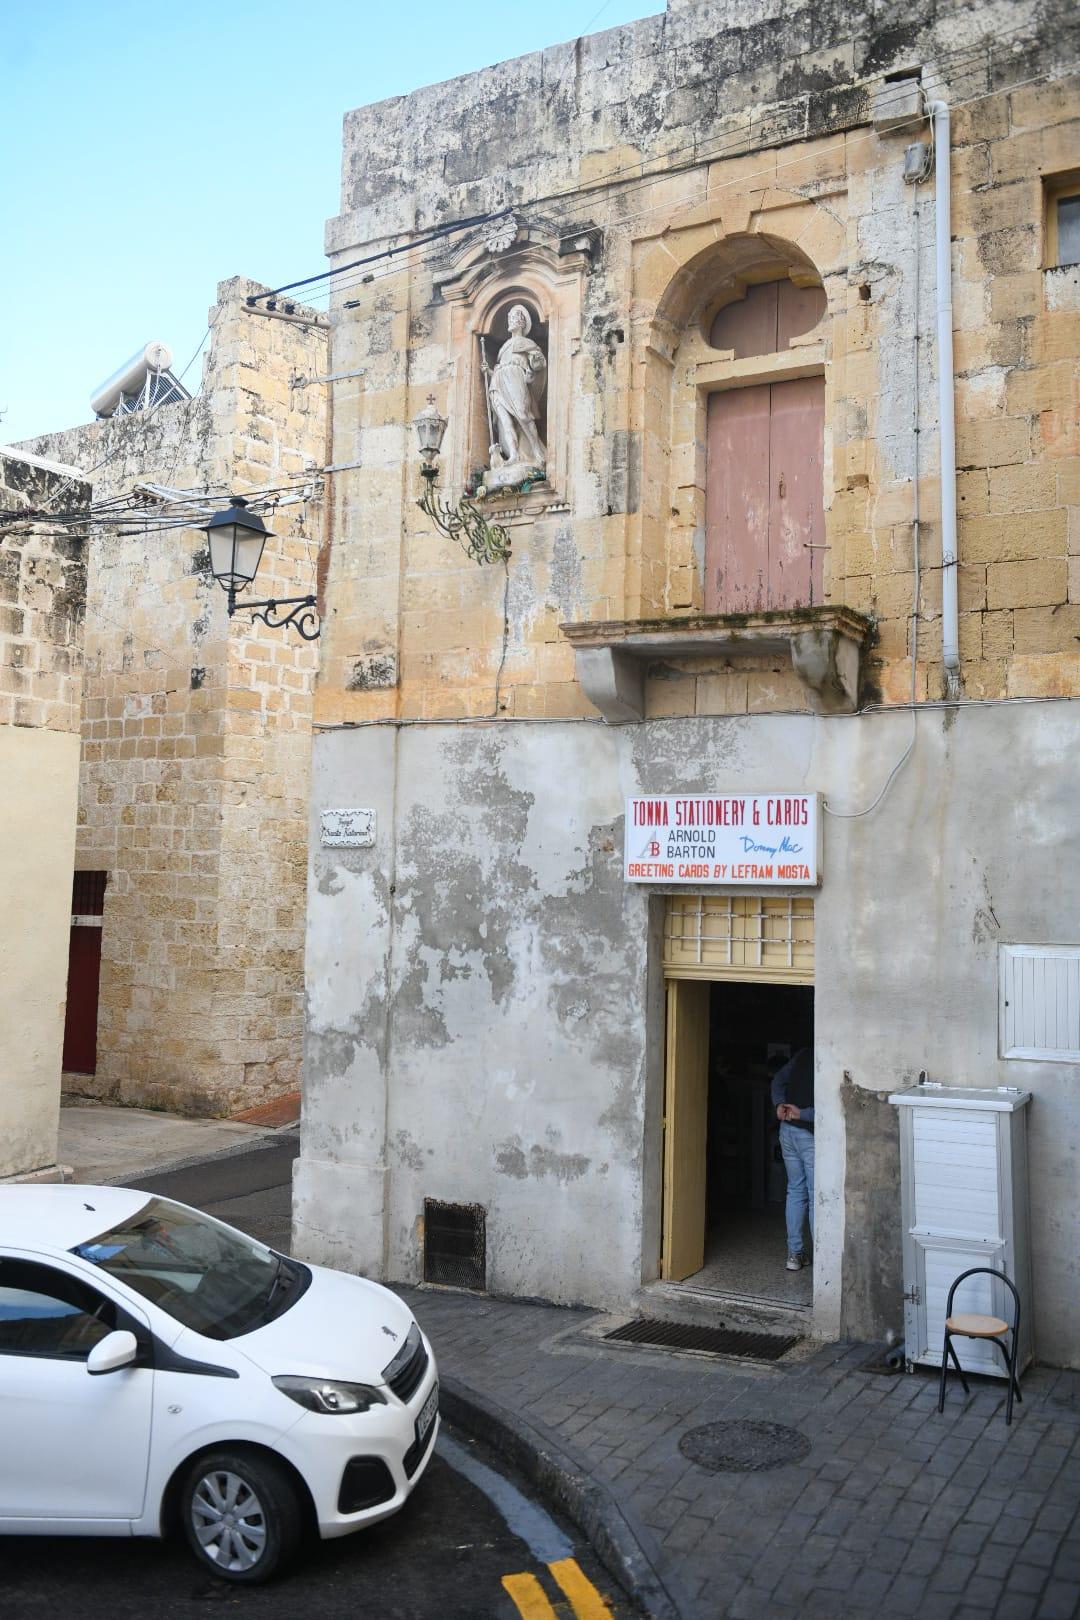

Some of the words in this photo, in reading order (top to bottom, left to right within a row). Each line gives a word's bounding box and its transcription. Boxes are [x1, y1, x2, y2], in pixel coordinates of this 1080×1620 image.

[633, 800, 669, 826] TONNA
[675, 799, 746, 826] STATIONERY
[752, 799, 760, 826] &
[767, 799, 808, 826] CARDS
[668, 829, 716, 843] ARNOLD
[667, 846, 716, 859] BARTON
[628, 863, 674, 878] GREETING
[678, 864, 709, 878] CARDS
[713, 864, 727, 879] BY
[731, 864, 773, 879] LEFRAM
[777, 865, 810, 879] MOSTA
